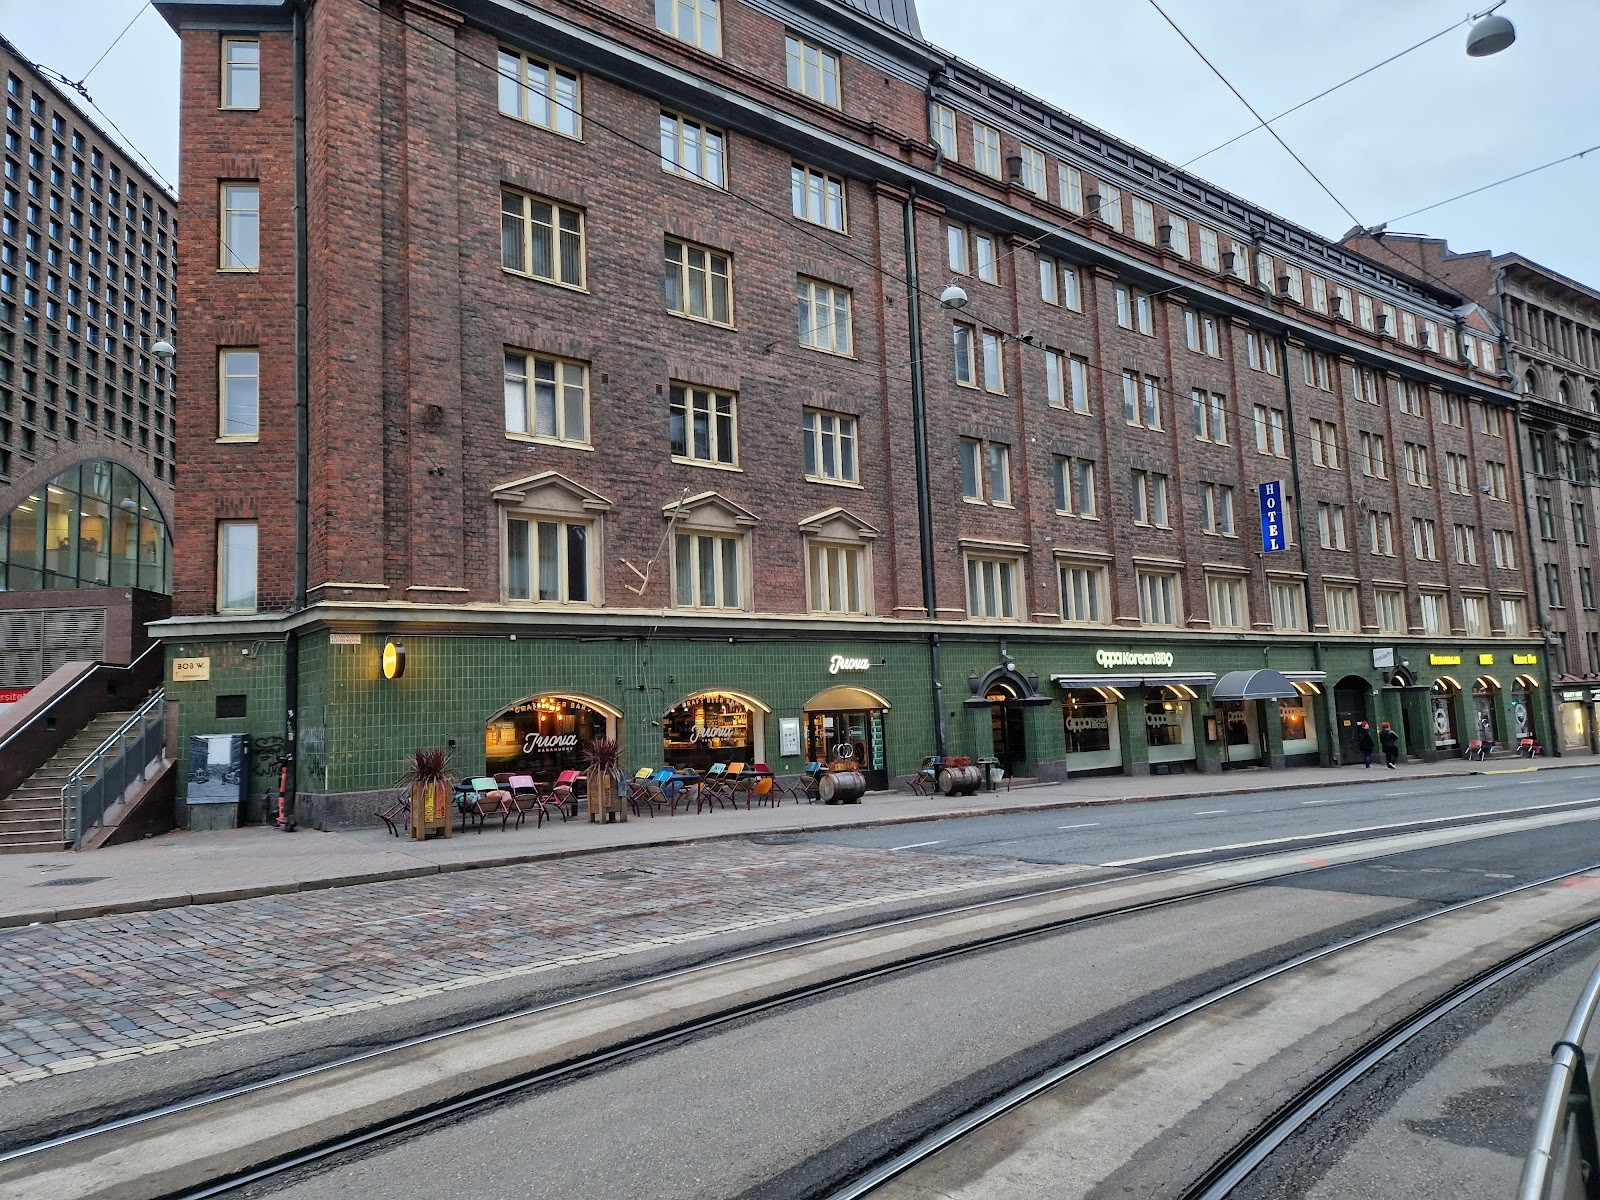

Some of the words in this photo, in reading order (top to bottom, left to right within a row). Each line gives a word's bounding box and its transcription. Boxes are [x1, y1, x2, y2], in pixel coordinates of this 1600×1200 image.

[1266, 484, 1279, 550] HOTEL
[829, 655, 870, 675] Juova
[1096, 650, 1122, 668] Oppa
[1123, 652, 1155, 665] Korean
[1155, 652, 1173, 667] BBQ
[570, 702, 586, 710] BAR
[1066, 716, 1092, 733] Oppa
[523, 732, 578, 753] Juova
